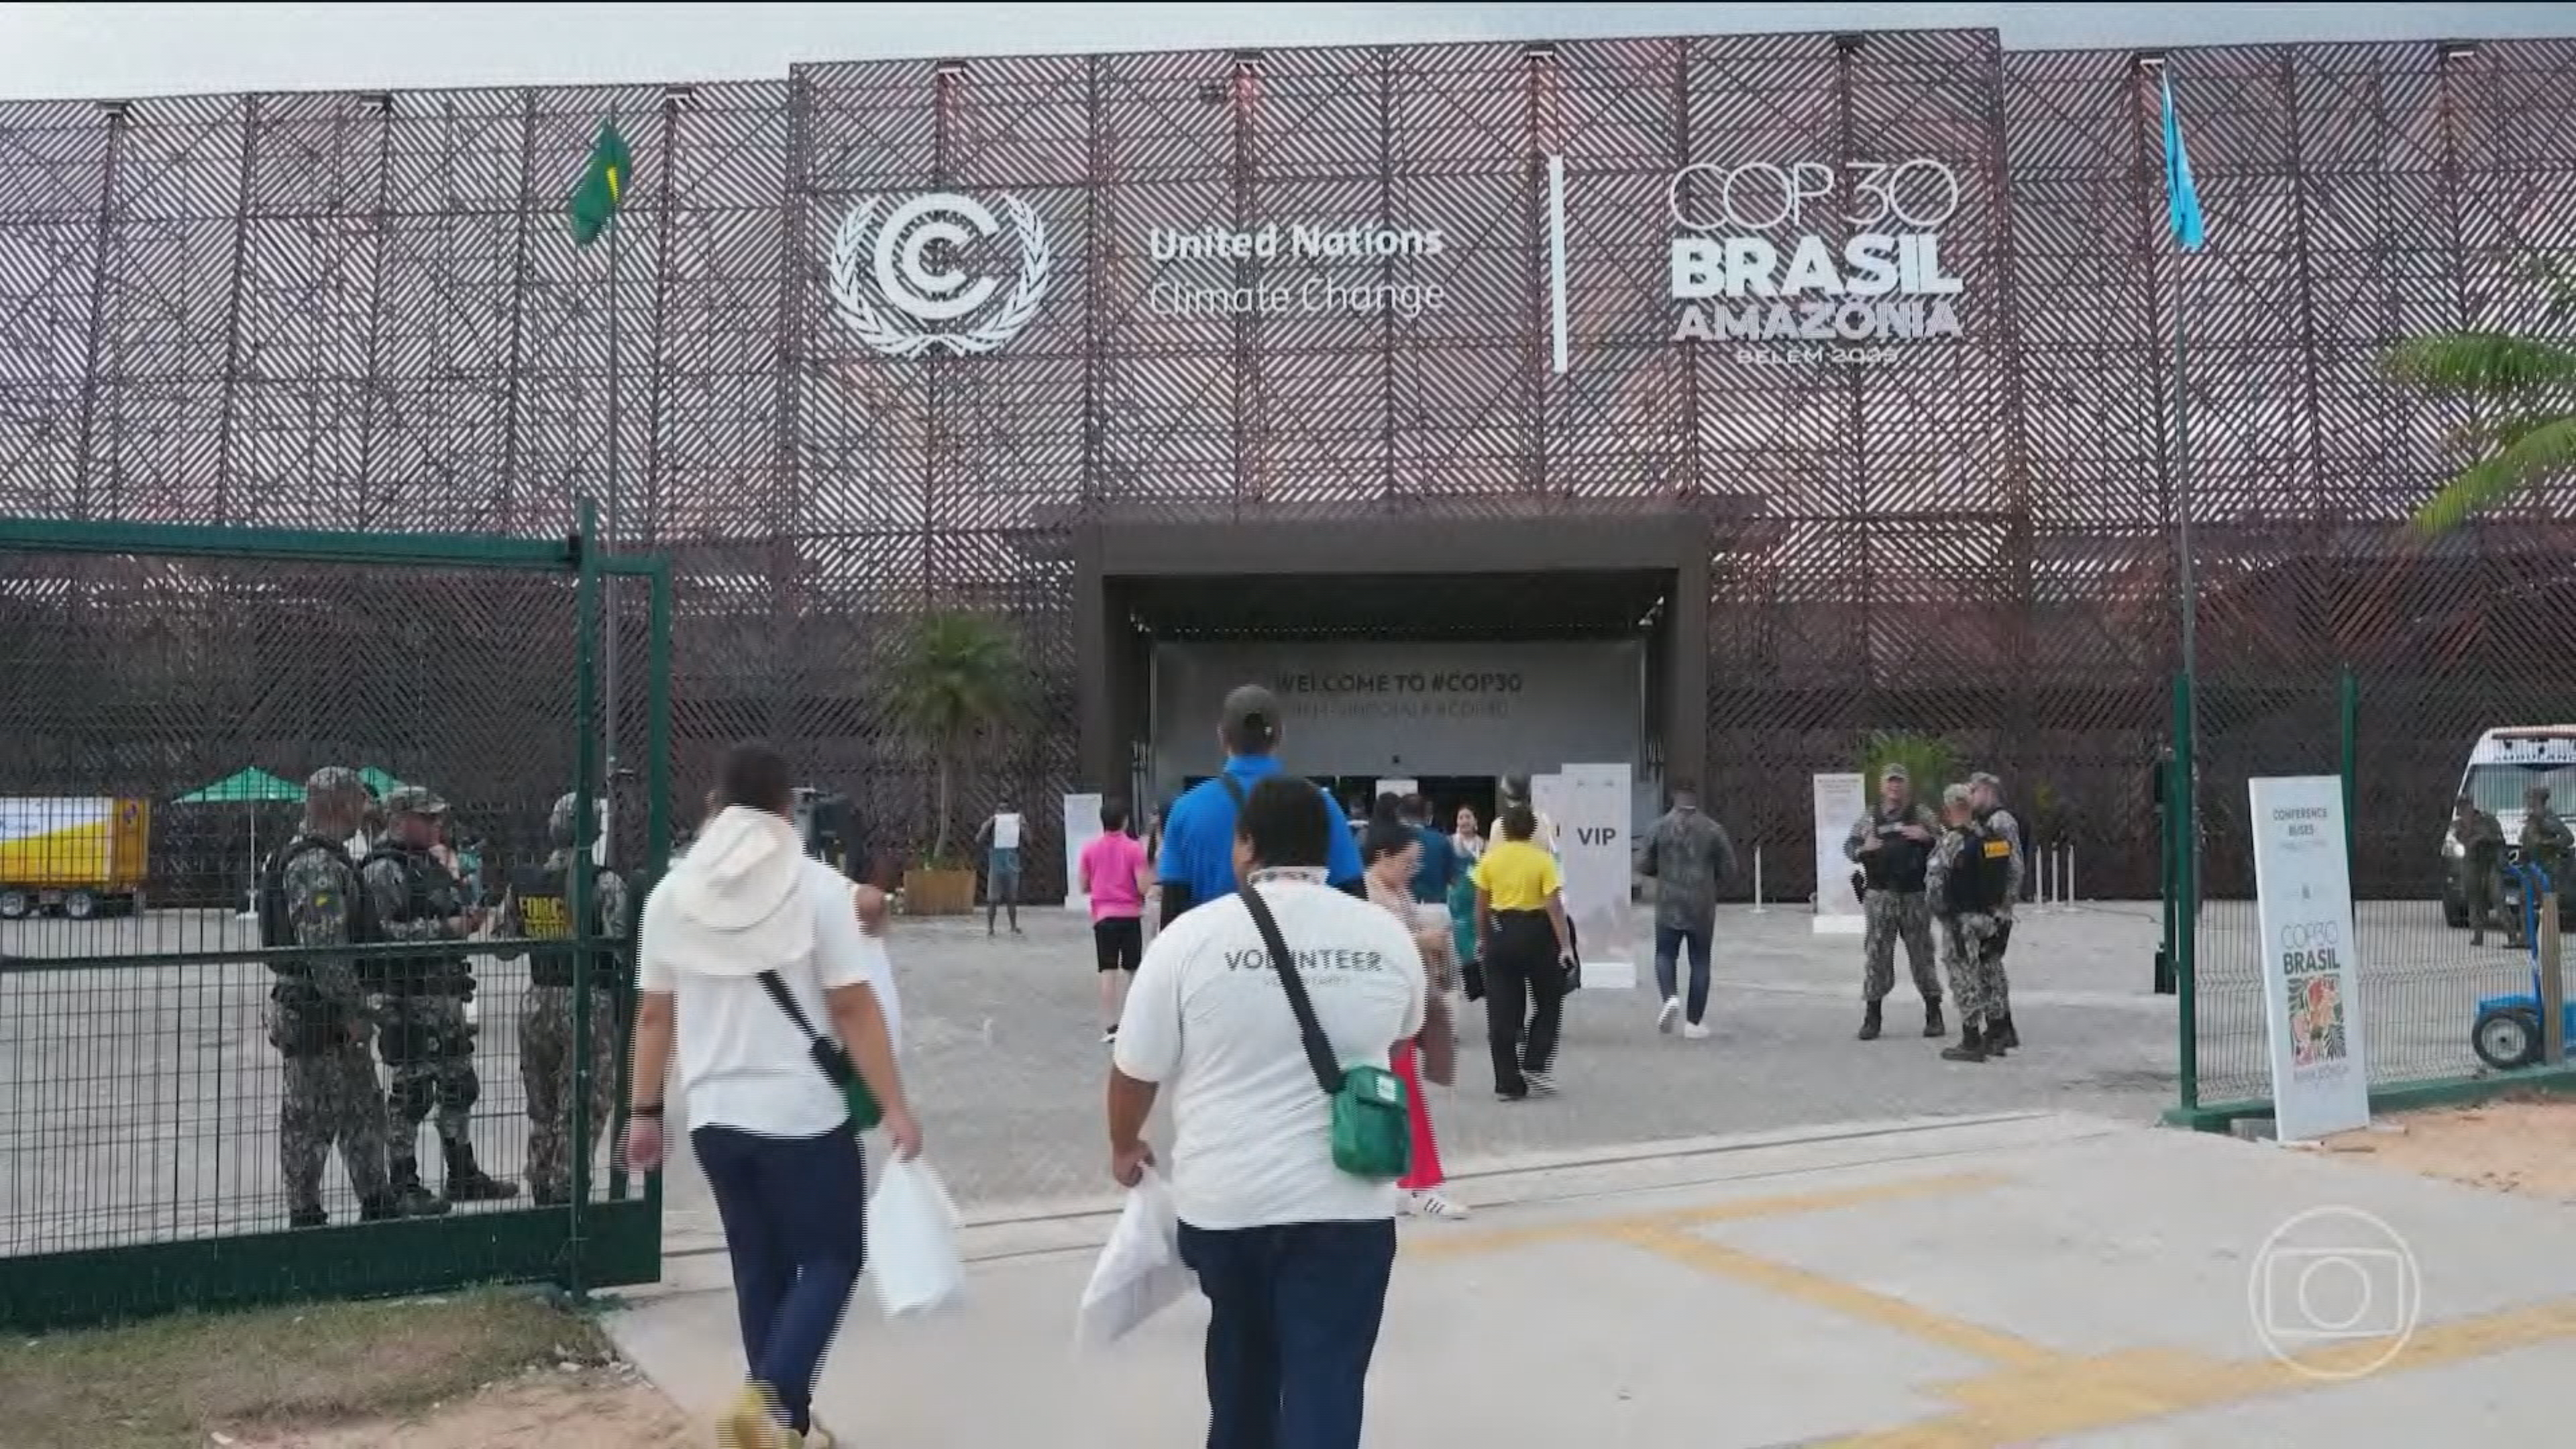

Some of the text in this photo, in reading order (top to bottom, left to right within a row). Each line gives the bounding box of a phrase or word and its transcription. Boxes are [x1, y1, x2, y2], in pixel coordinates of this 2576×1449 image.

[1150, 222, 1442, 260] United Nations
[1672, 233, 1963, 299] BRASIL
[1151, 277, 1444, 318] Climate Change
[1670, 292, 1964, 341] AMAZÔNIA
[1832, 347, 1899, 364] 2025
[1277, 673, 1523, 693] WELCOME TO #COP30
[2273, 808, 2328, 821] CONFERENCE
[1577, 827, 1616, 846] VIP
[2283, 947, 2341, 975] BRASIL
